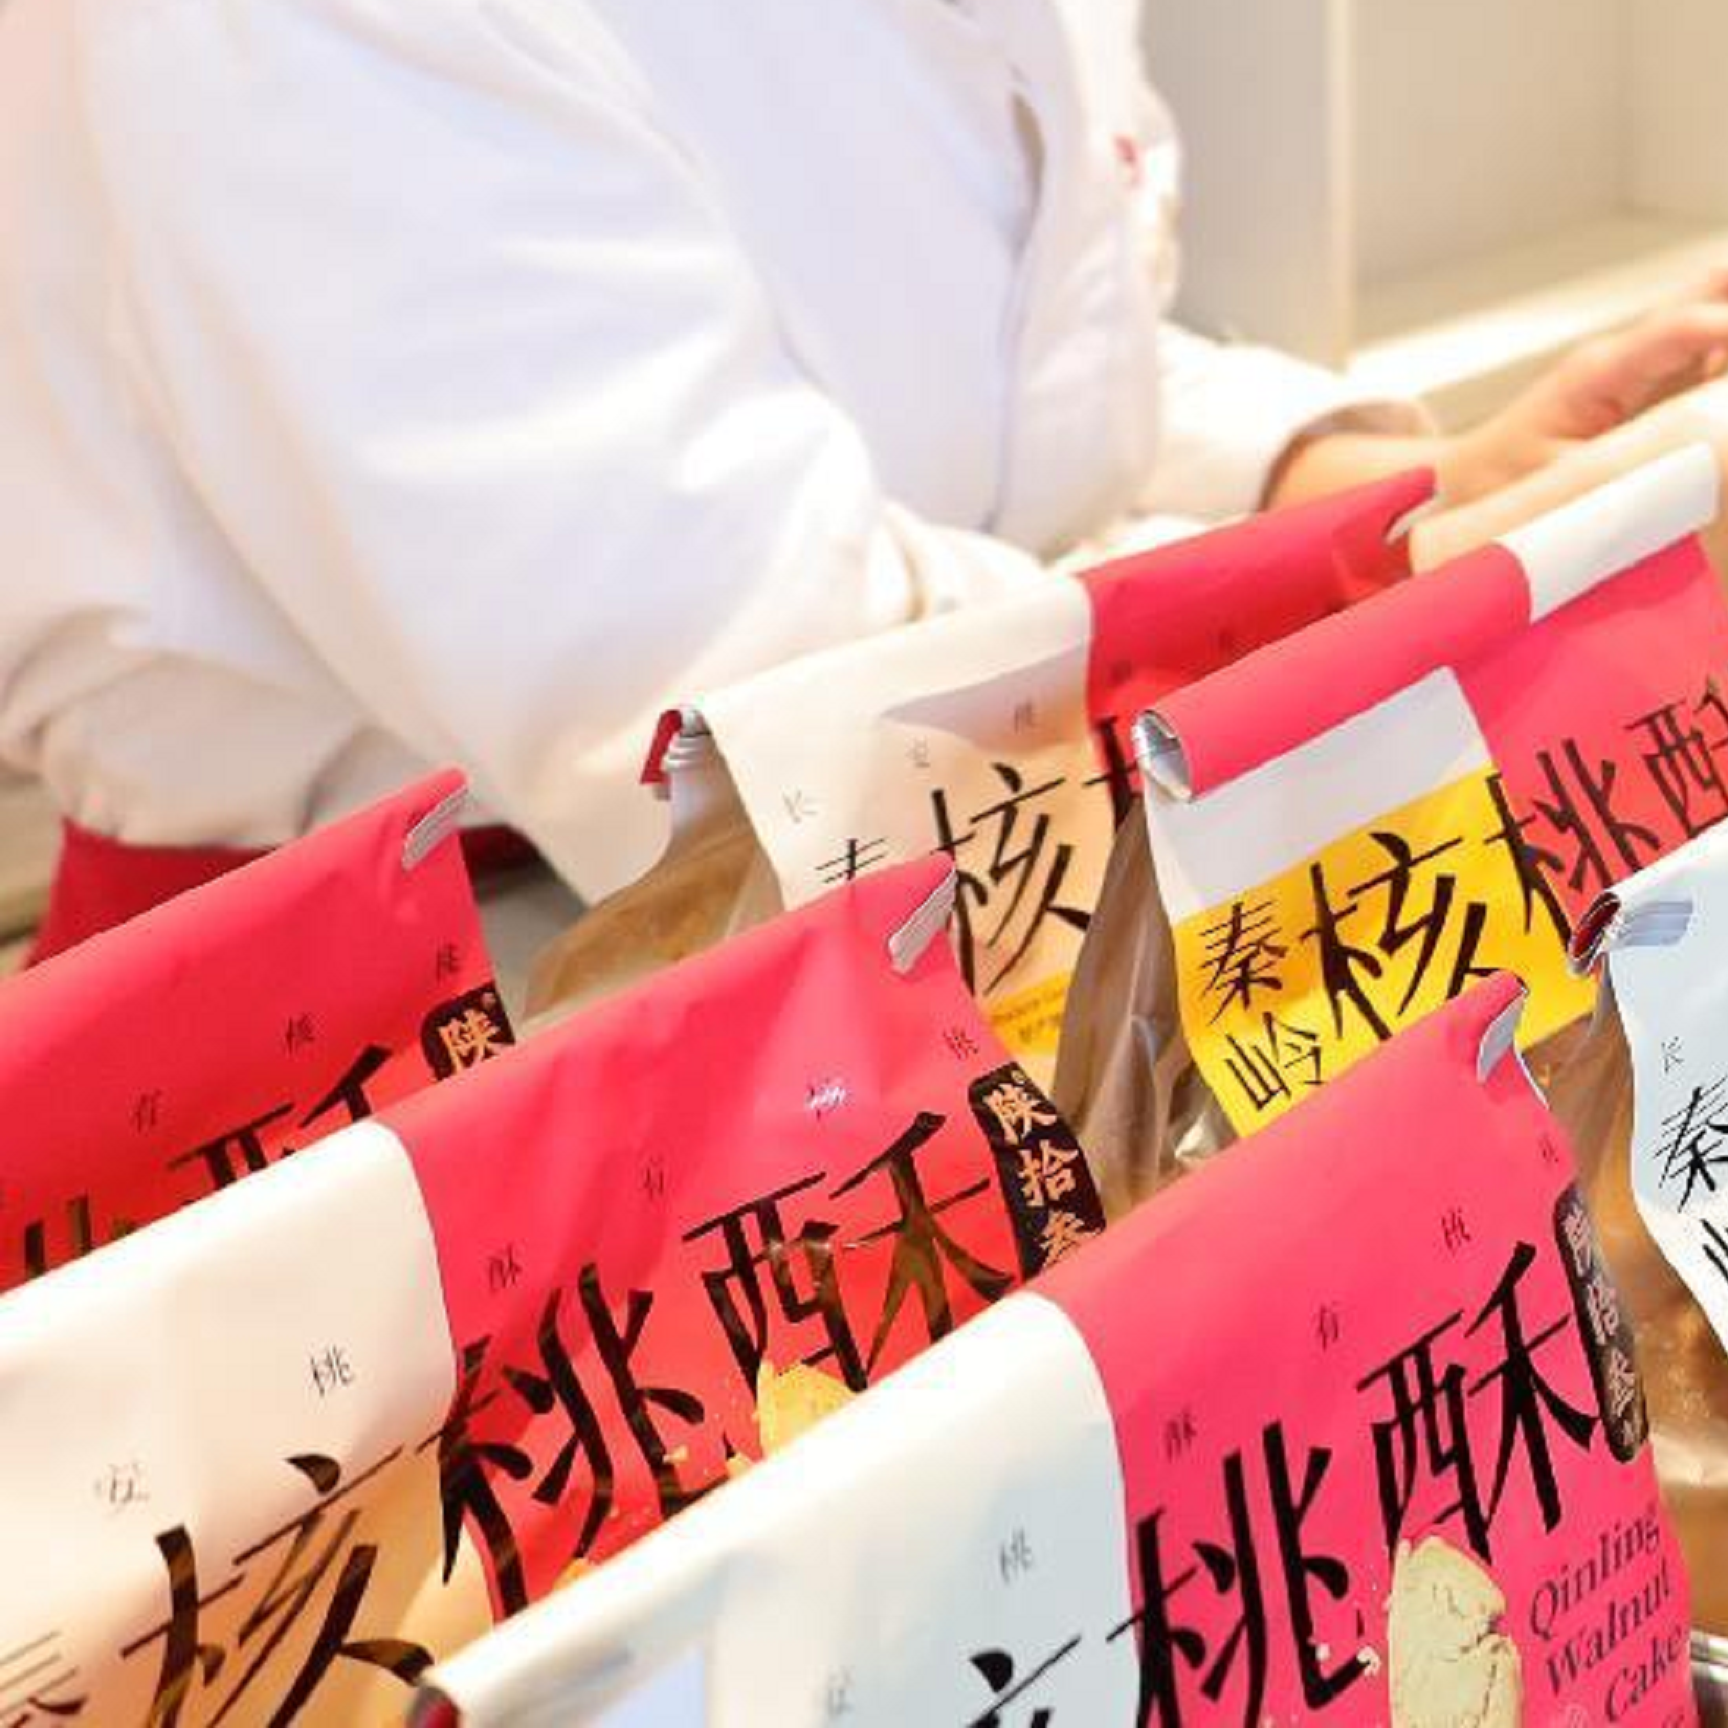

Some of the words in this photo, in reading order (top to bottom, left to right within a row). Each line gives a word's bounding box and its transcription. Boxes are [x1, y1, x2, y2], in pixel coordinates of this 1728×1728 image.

[1198, 902, 1326, 1110] 秦岭
[1530, 1517, 1660, 1641] Qinling
[1547, 1557, 1670, 1697] Walnut
[1606, 1626, 1682, 1723] Cake
